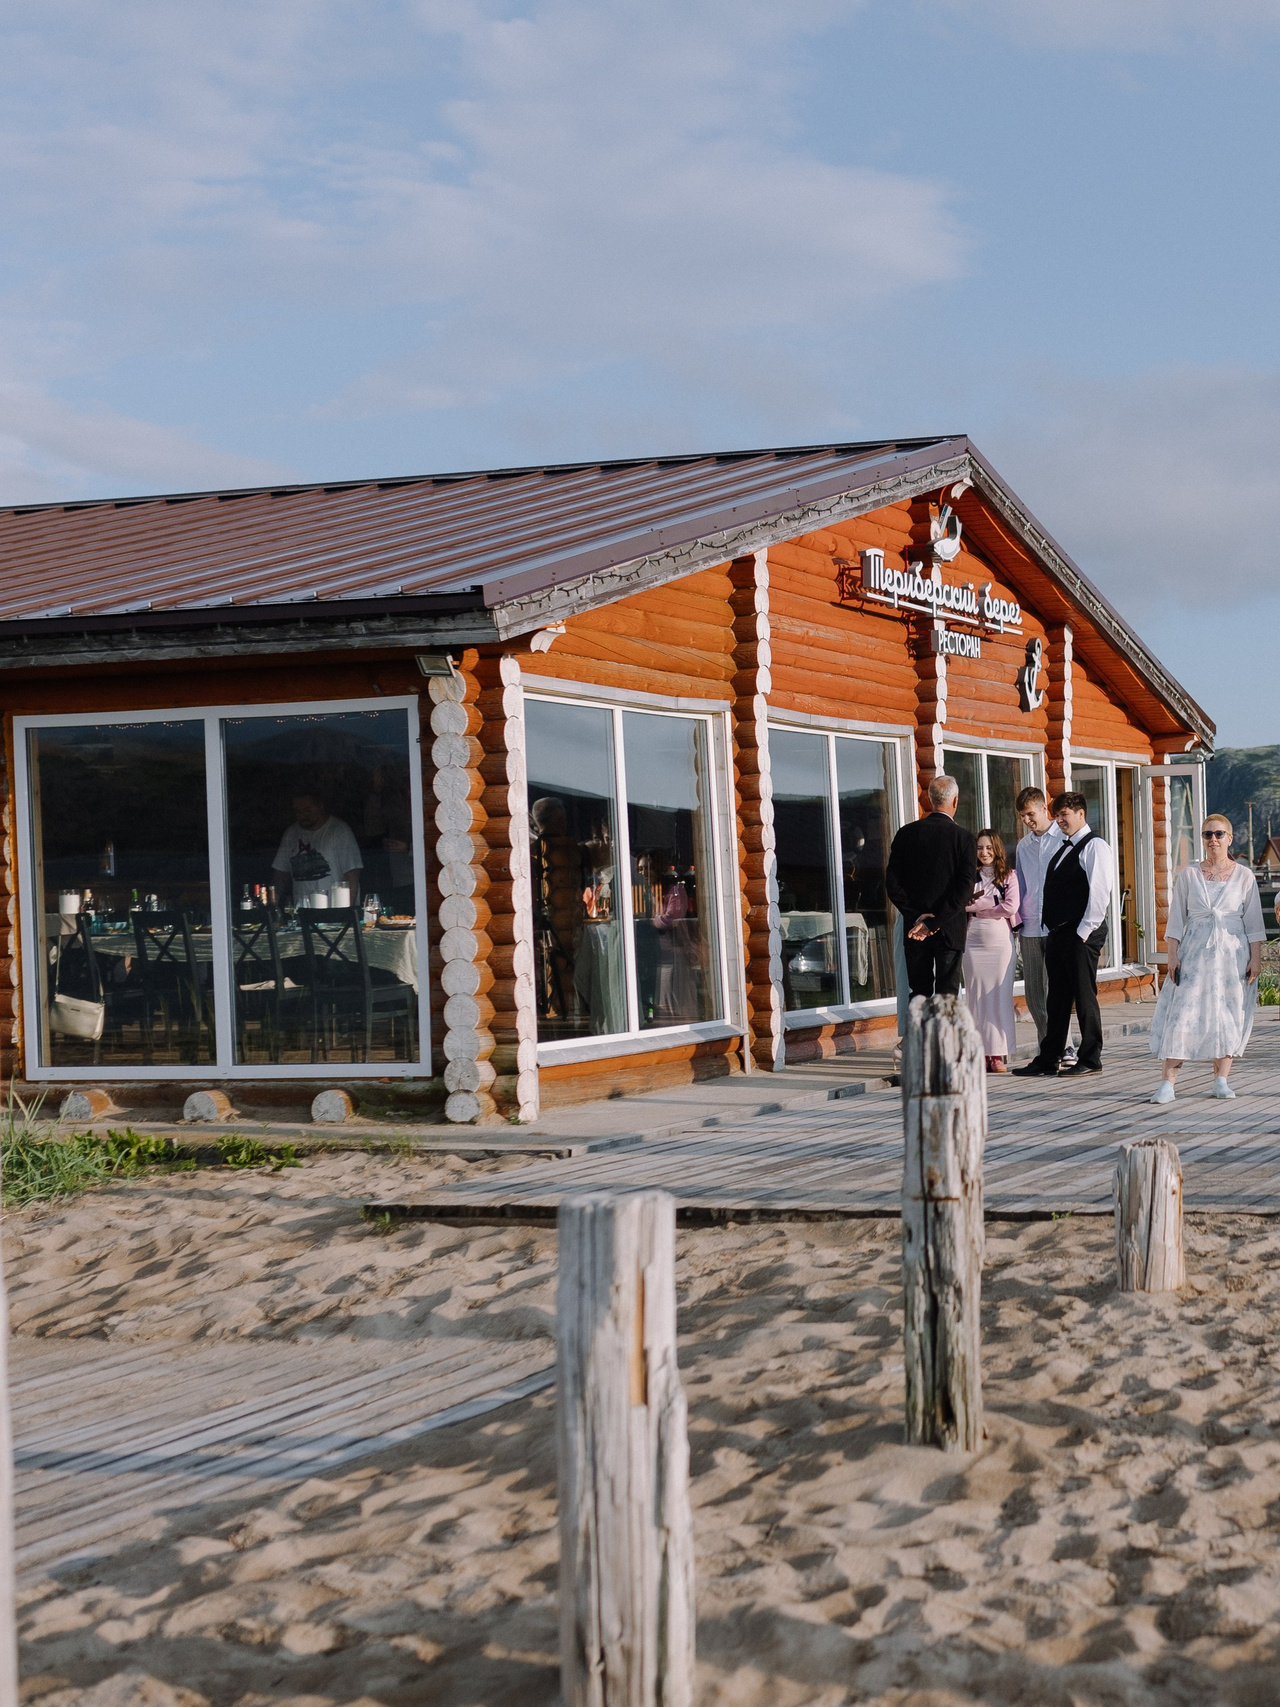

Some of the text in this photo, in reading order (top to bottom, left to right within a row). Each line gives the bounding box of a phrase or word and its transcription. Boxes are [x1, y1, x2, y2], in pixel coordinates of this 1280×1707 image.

[865, 547, 1023, 634] Териберский берег
[938, 629, 981, 659] РЕСТОРАН
